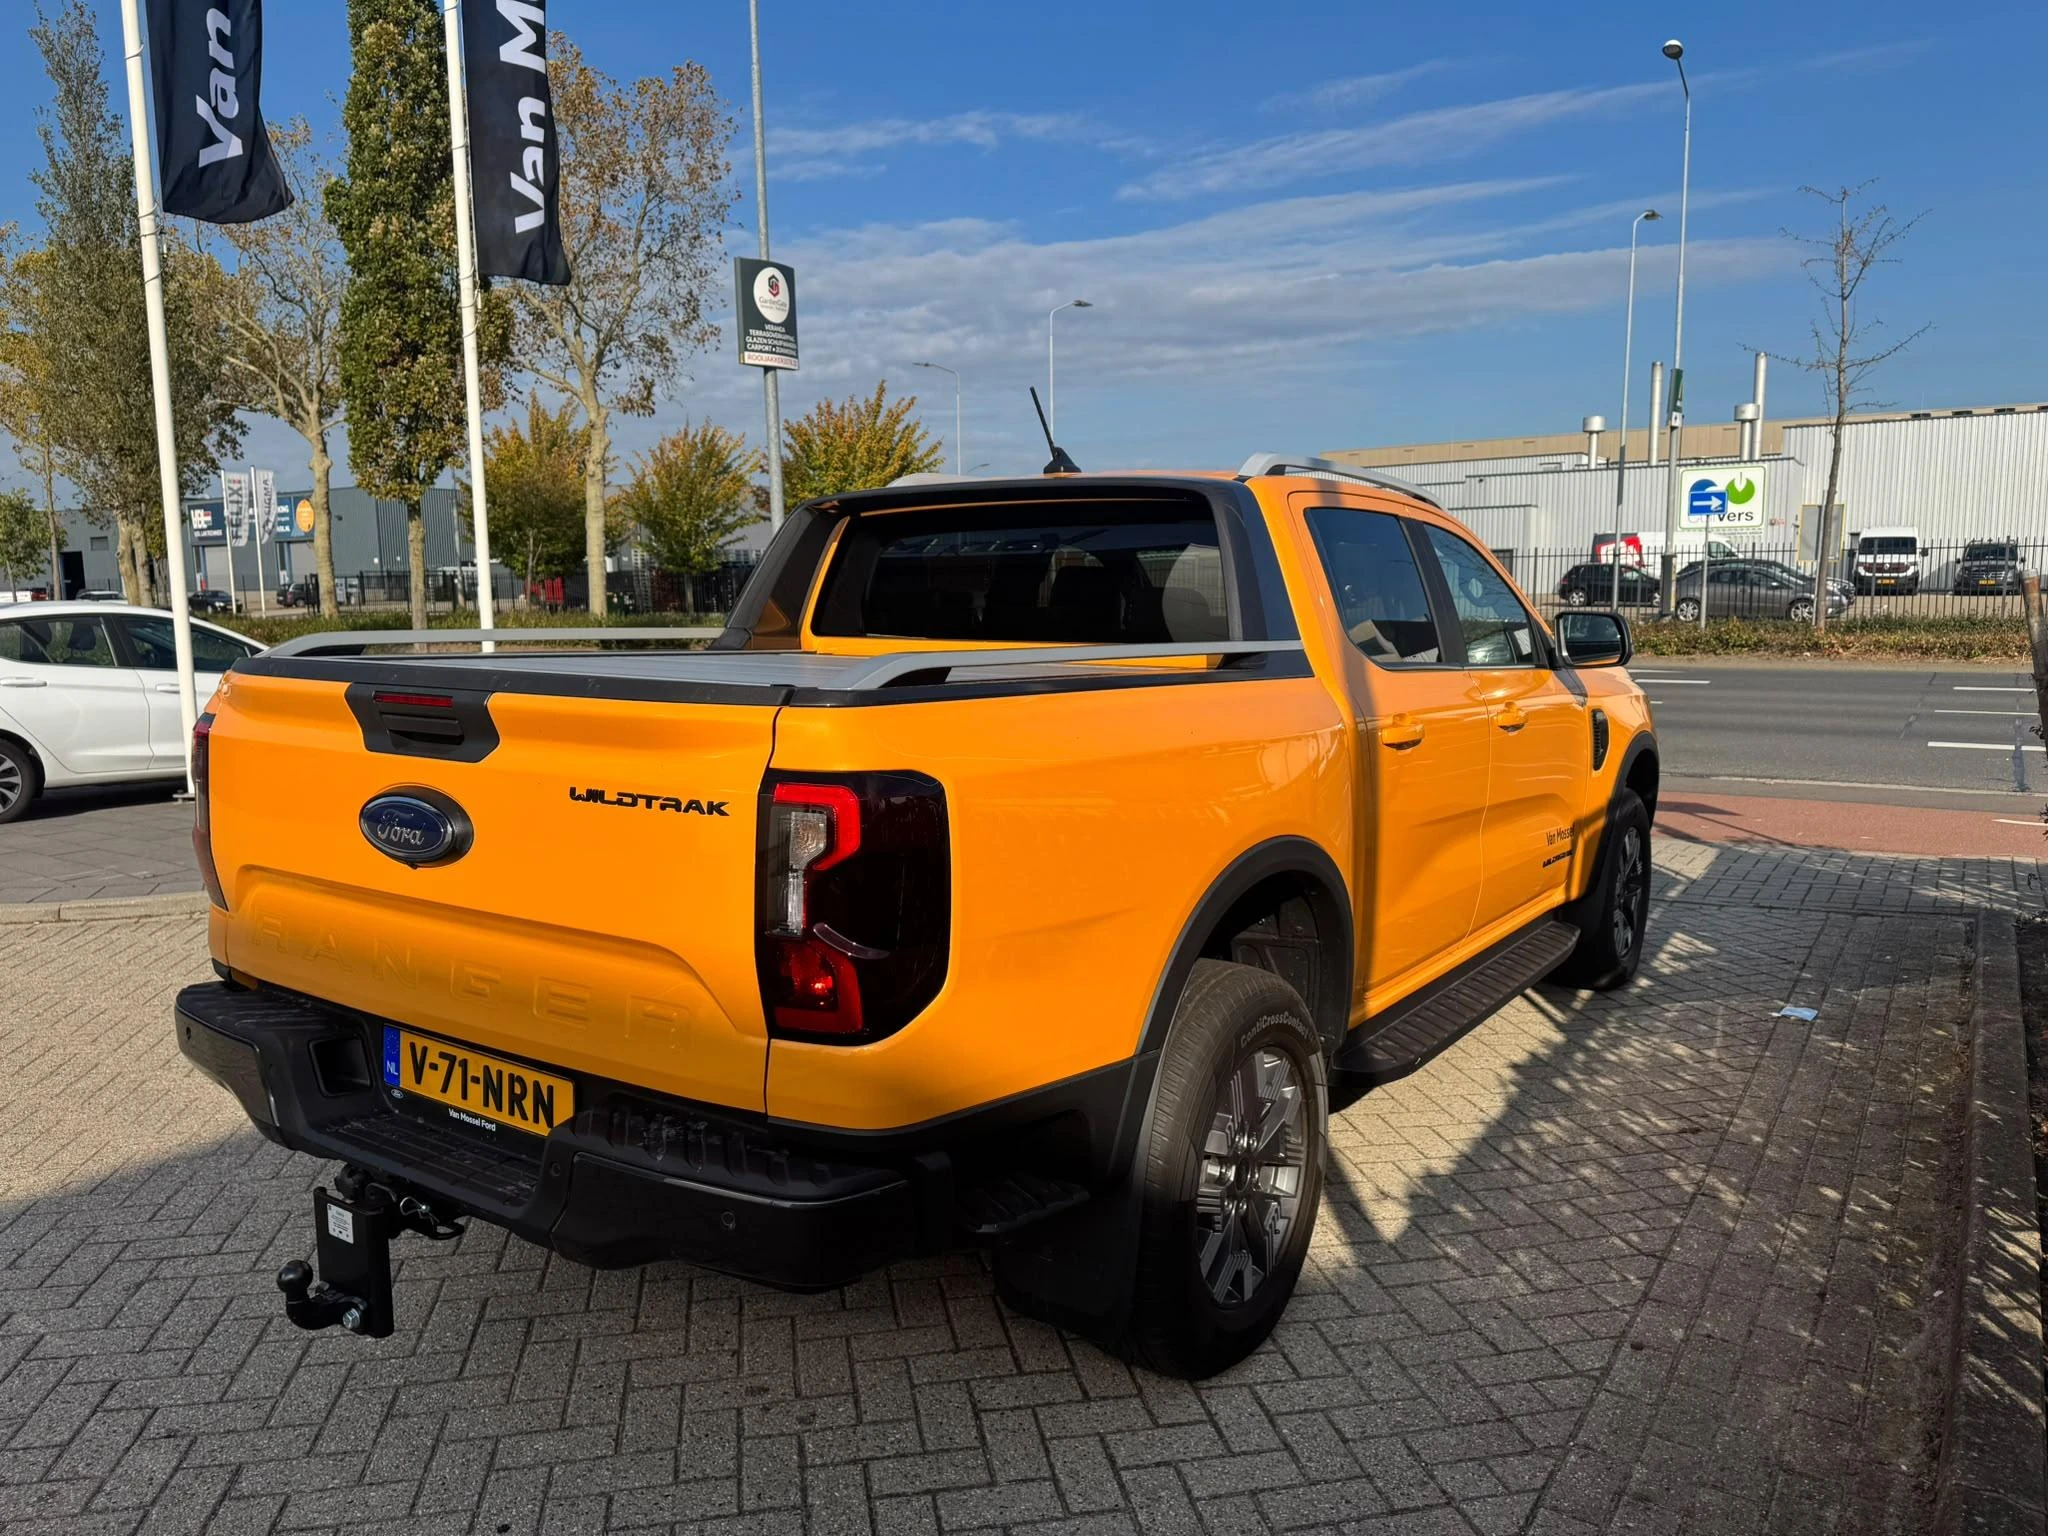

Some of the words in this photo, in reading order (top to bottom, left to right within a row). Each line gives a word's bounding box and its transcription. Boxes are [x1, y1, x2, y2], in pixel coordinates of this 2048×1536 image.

[497, 0, 546, 75] M
[196, 8, 244, 168] Van
[510, 96, 546, 235] Van
[227, 485, 243, 540] FELIX
[376, 809, 425, 847] Ford
[569, 786, 730, 817] WILDTRAK
[249, 909, 694, 1052] RANGER
[386, 1060, 399, 1076] NL
[409, 1041, 554, 1129] V-71-NRN
[448, 1107, 460, 1119] Van
[460, 1113, 481, 1126] Mossel
[481, 1119, 496, 1132] Ford
